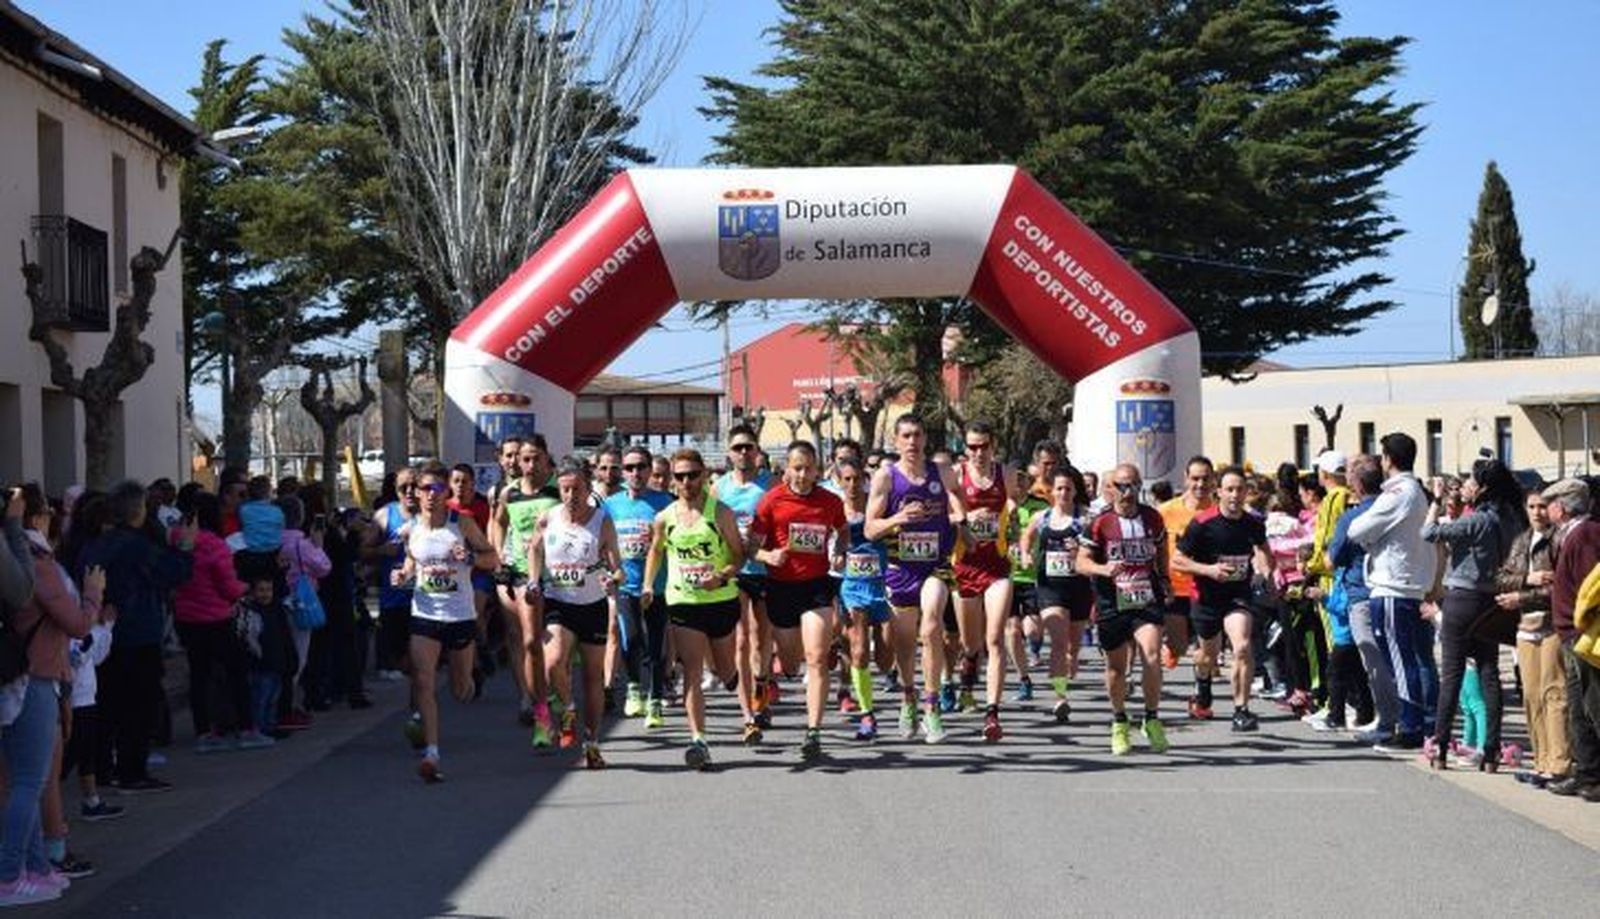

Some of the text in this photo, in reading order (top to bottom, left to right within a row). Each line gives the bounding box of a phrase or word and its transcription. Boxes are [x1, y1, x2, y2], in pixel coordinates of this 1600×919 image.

[785, 239, 931, 262] de Salamanca
[786, 197, 907, 223] Diputación
[505, 226, 652, 362] CON EL DEPORTE
[1003, 239, 1121, 347] DEPORTISTAS
[1014, 215, 1147, 335] CON NUESTROS
